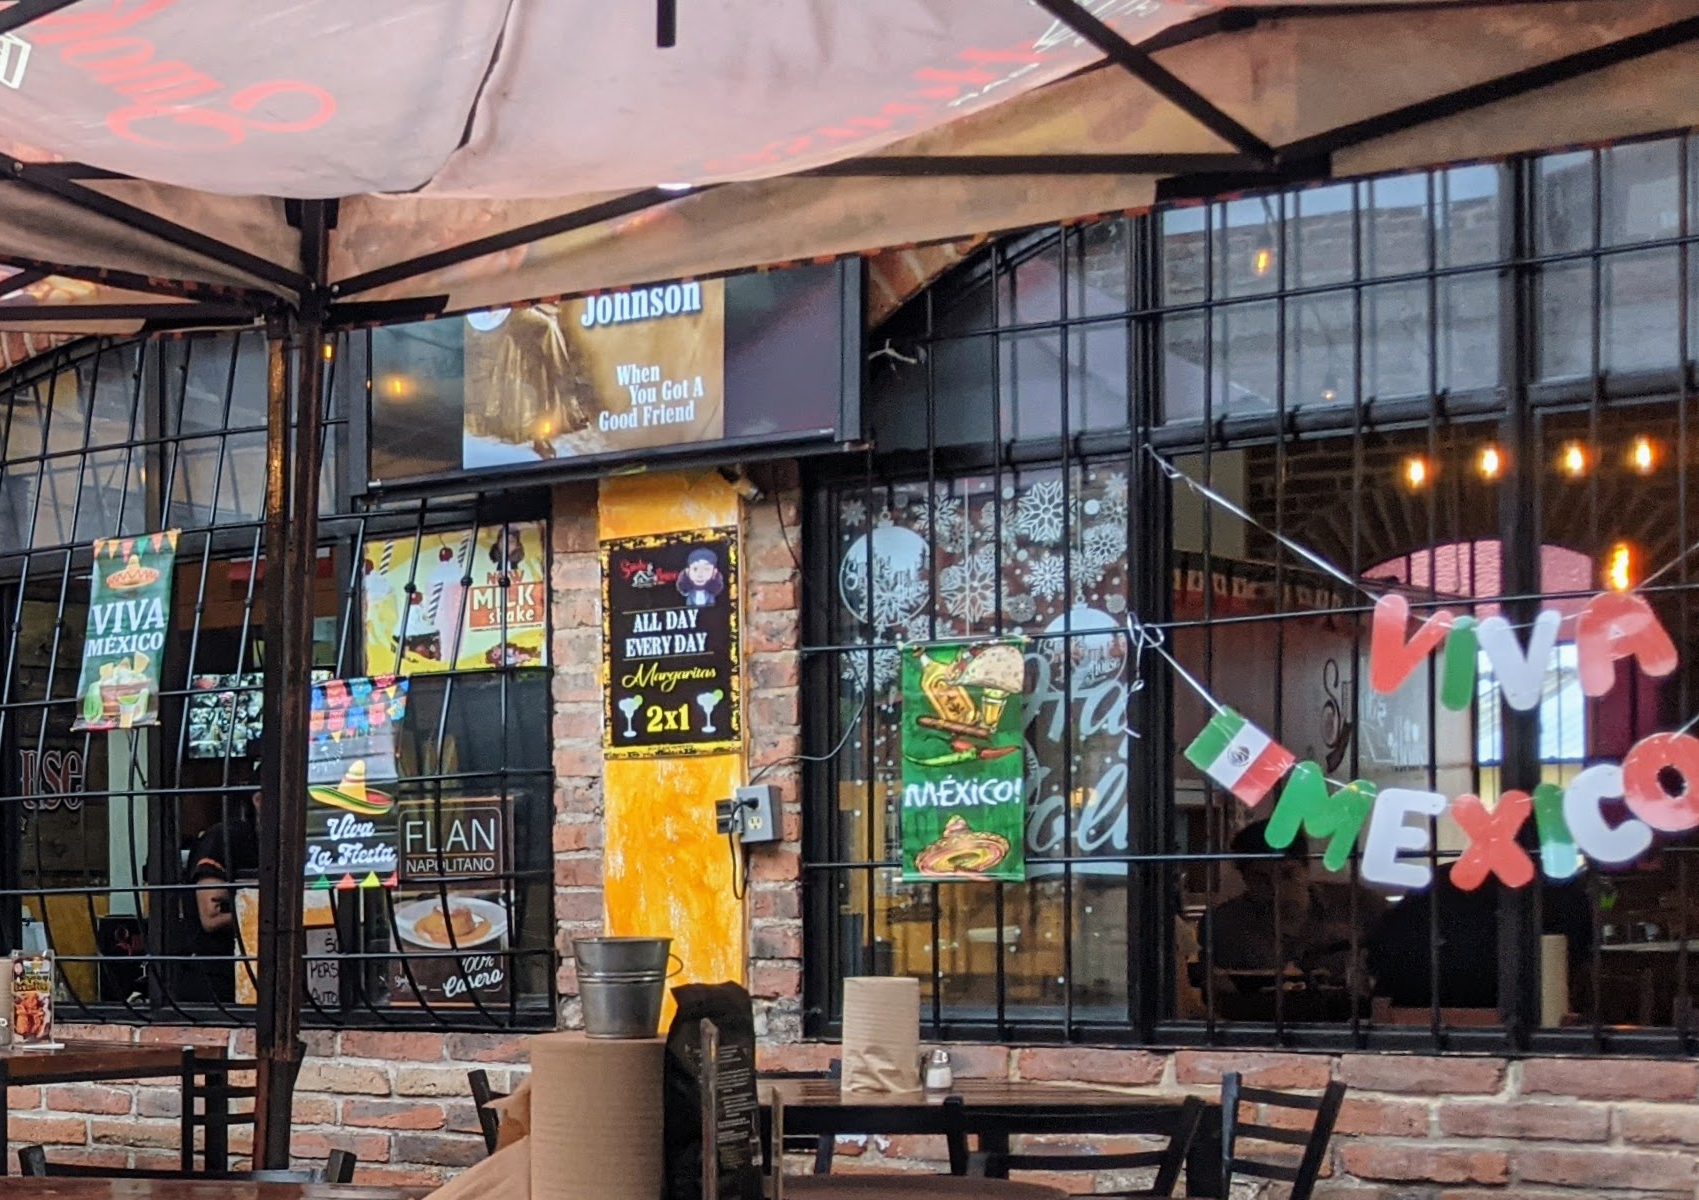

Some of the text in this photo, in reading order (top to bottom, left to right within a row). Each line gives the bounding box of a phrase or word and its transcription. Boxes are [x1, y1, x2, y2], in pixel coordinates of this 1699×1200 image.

[616, 363, 661, 386] When
[629, 376, 705, 406] You Got A
[598, 400, 695, 432] Good Friend
[92, 597, 165, 635] VIVA
[632, 608, 699, 634] ALL DAY
[86, 631, 164, 658] MÉXICO
[624, 632, 708, 659] EVERY DAY
[1368, 591, 1678, 712] VIVA
[621, 661, 717, 693] Margaritas
[646, 703, 691, 732] 2x1
[904, 774, 1022, 808] MÉXICO!
[1264, 731, 1699, 891] MEXICO
[326, 813, 376, 841] Viva
[406, 818, 495, 853] FLAN
[305, 842, 398, 873] La Fiesta
